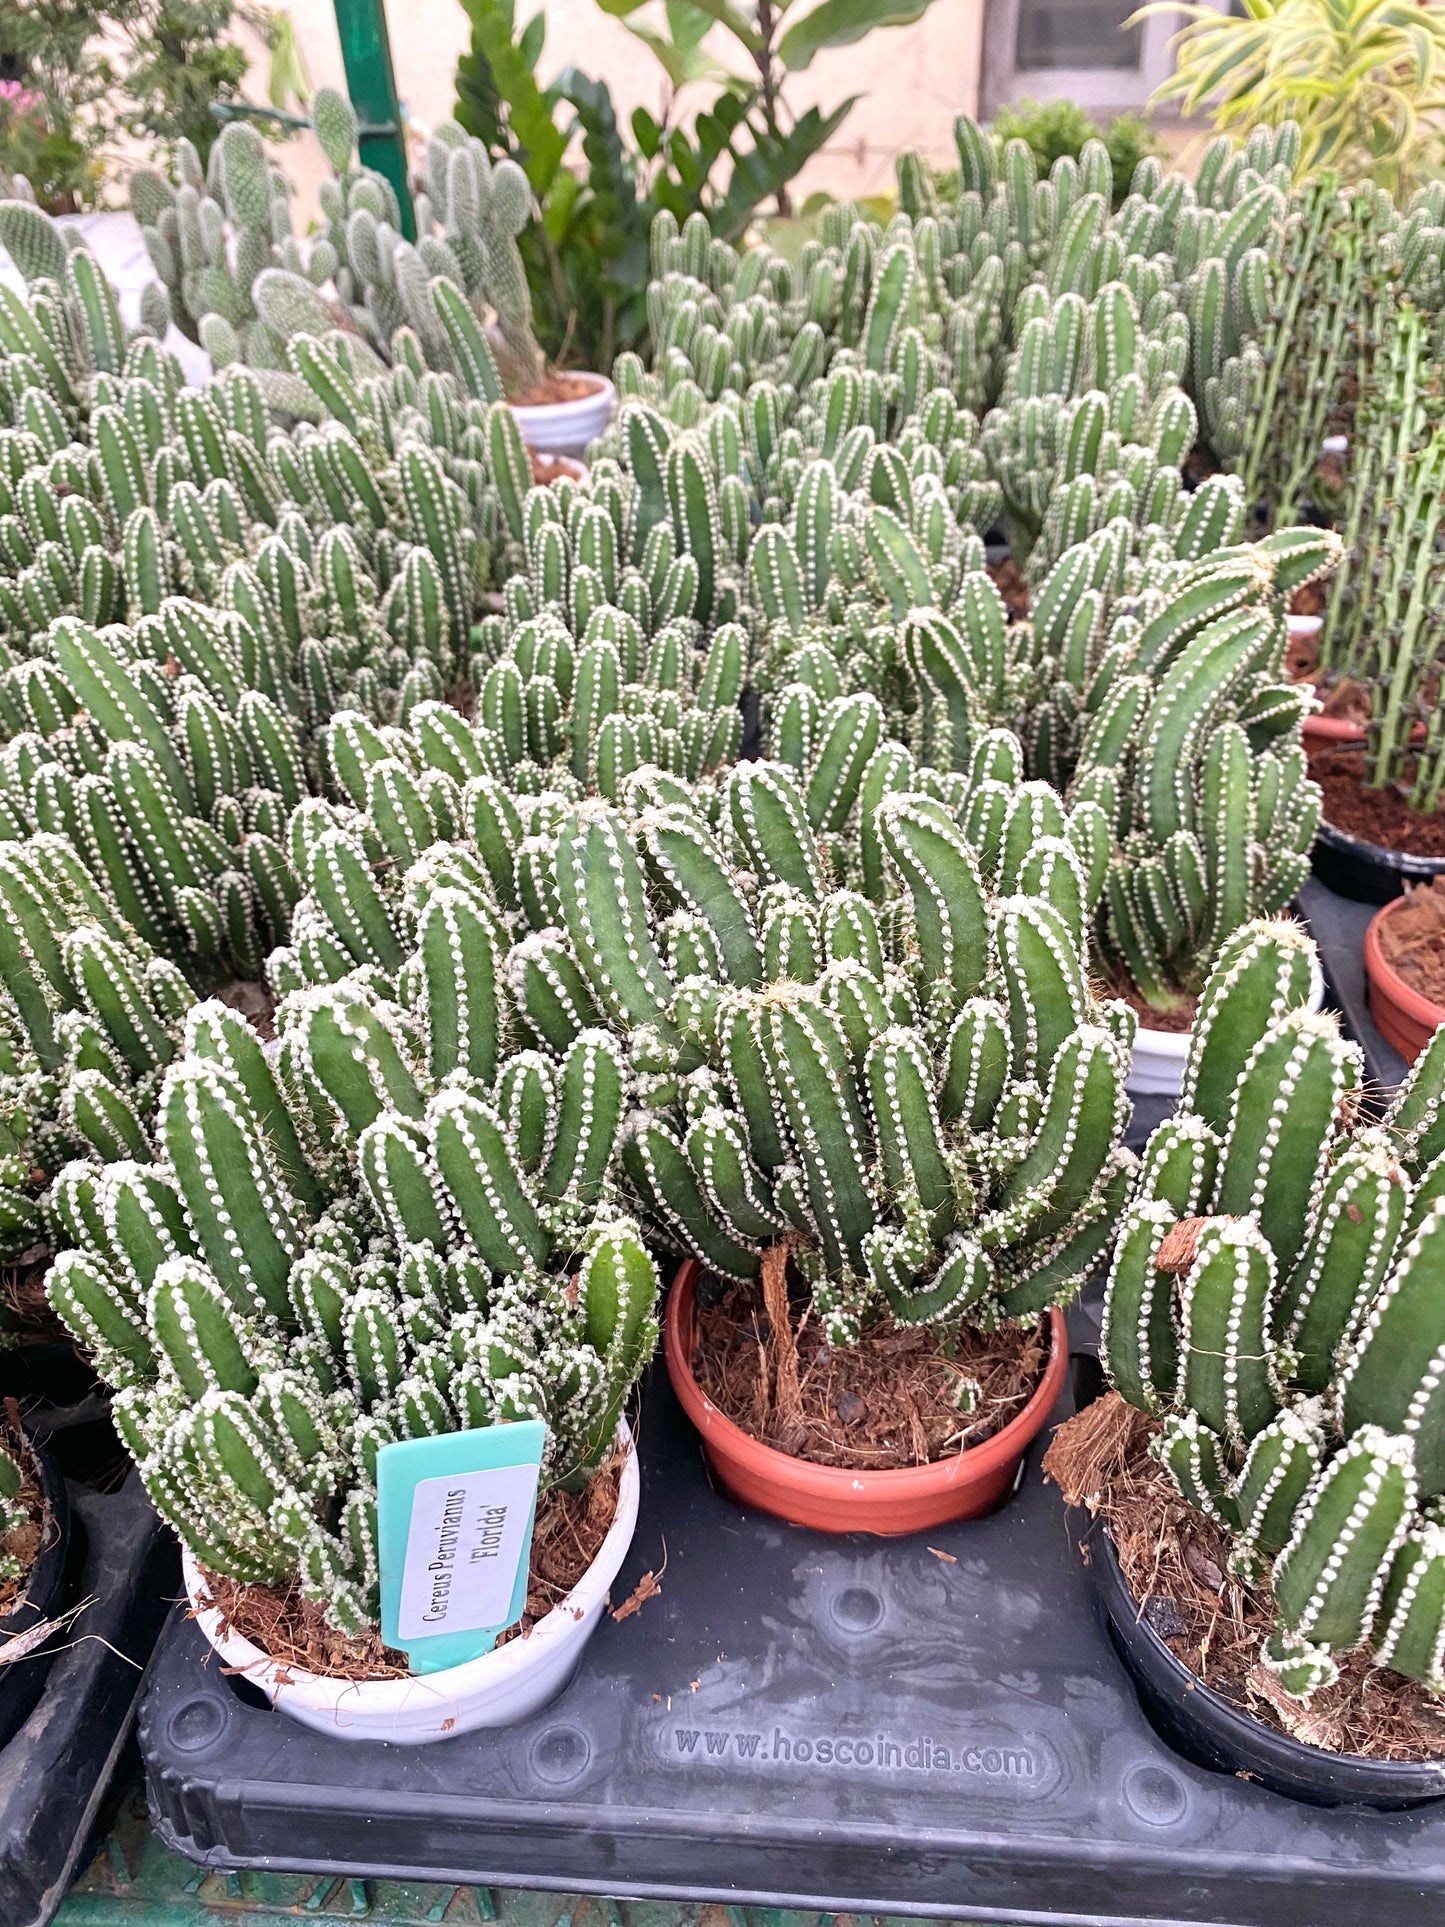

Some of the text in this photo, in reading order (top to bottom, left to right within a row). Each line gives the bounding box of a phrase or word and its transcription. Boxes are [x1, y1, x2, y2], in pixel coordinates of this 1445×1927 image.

[422, 1489, 467, 1622] Cereus Peruvianus
[469, 1504, 508, 1564] 'Florida'
[675, 1727, 1034, 1776] www.hoscoindia.com
